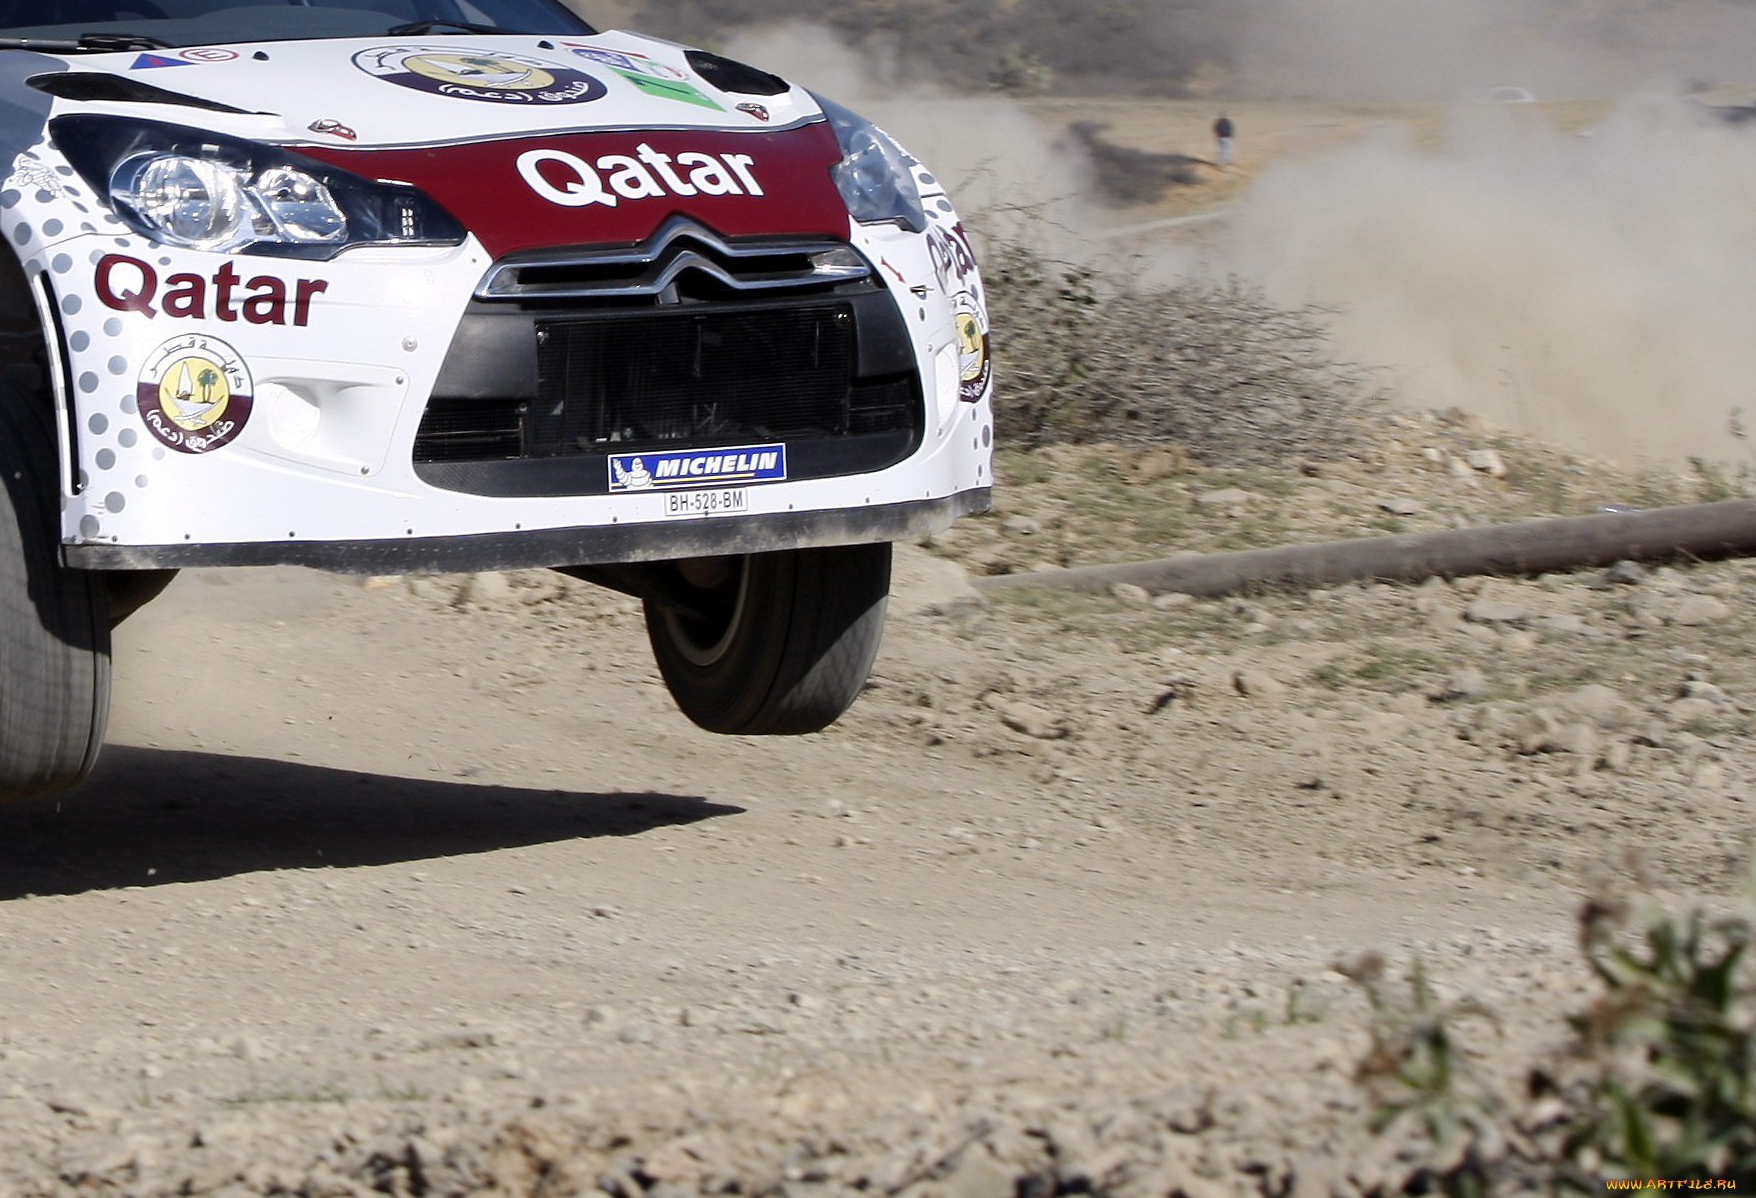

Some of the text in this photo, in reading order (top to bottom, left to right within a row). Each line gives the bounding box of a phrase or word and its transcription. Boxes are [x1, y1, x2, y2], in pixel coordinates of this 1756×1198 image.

[515, 143, 765, 207] Qatar
[94, 253, 330, 327] Qatar
[655, 452, 778, 478] MICHELIN
[669, 490, 744, 512] BH-528-BM
